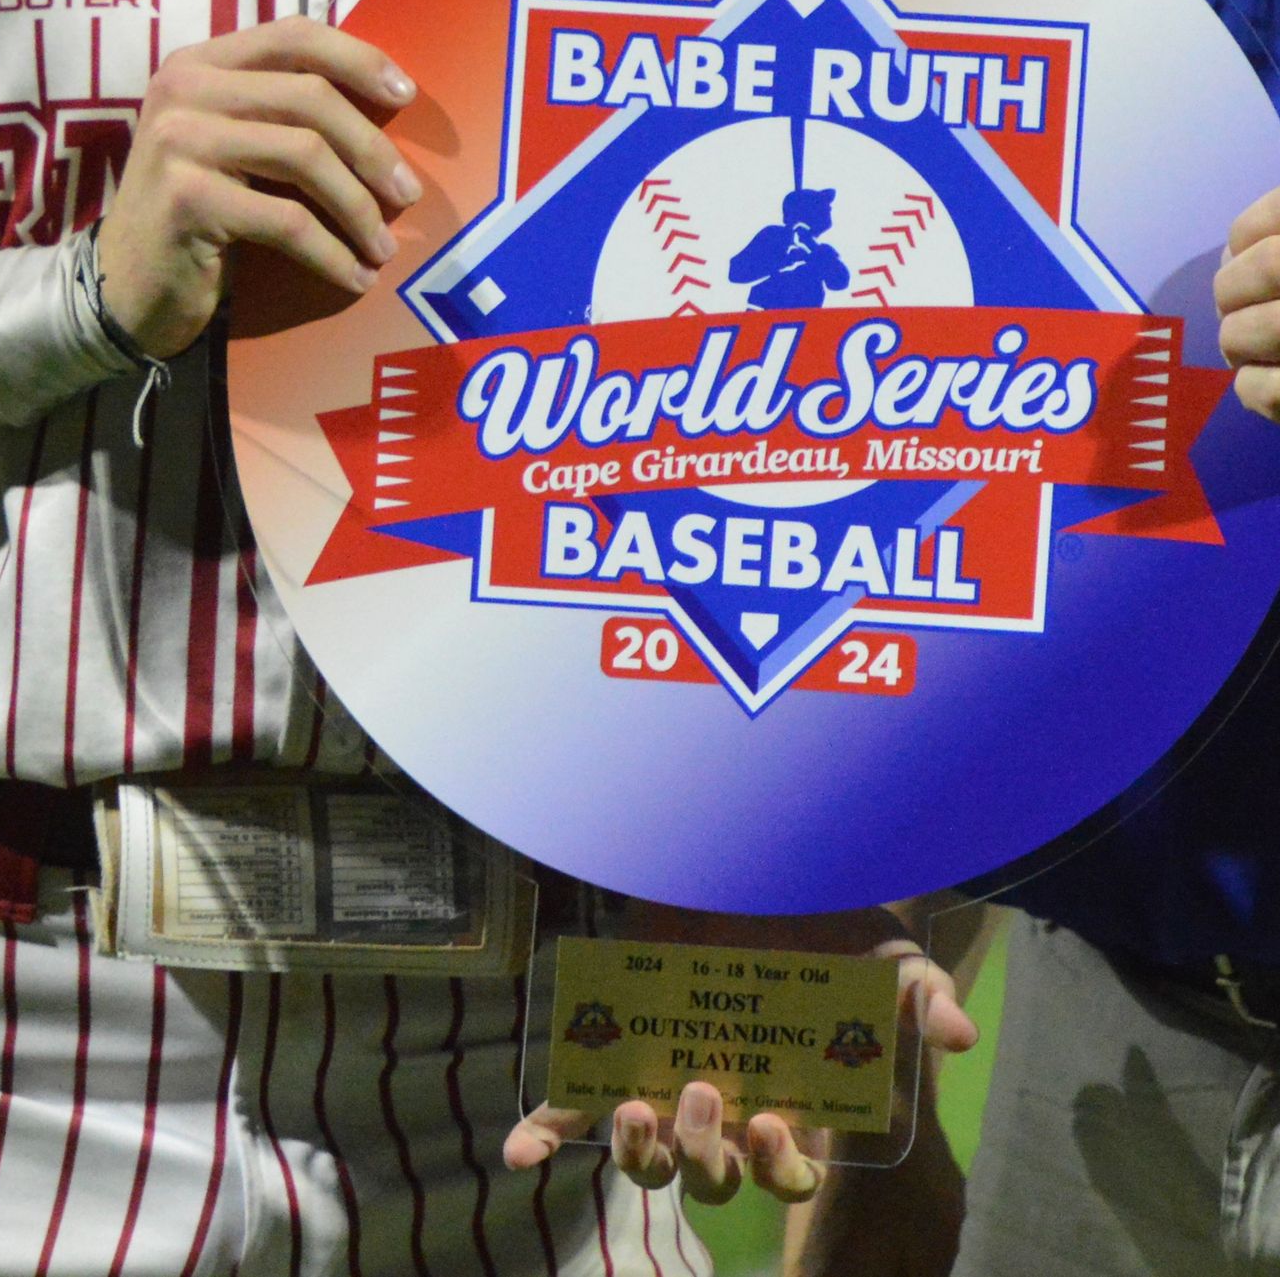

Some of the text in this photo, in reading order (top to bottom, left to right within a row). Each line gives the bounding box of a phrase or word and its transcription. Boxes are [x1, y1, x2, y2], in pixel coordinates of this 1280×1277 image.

[549, 30, 1047, 131] BABE RUTH
[459, 319, 1096, 457] World Series
[521, 438, 1044, 498] Cape Girardeau, Missouri
[544, 504, 978, 601] BASEBALL
[611, 624, 903, 686] 20 24
[625, 955, 663, 972] 2024
[691, 959, 710, 976] 16
[726, 962, 745, 978] 18
[753, 963, 791, 982] Year
[799, 967, 830, 984] Old
[688, 989, 764, 1014] MOST
[628, 1015, 817, 1047] OUTSTANDING
[671, 1048, 772, 1074] PLAYER
[637, 1086, 671, 1100] World
